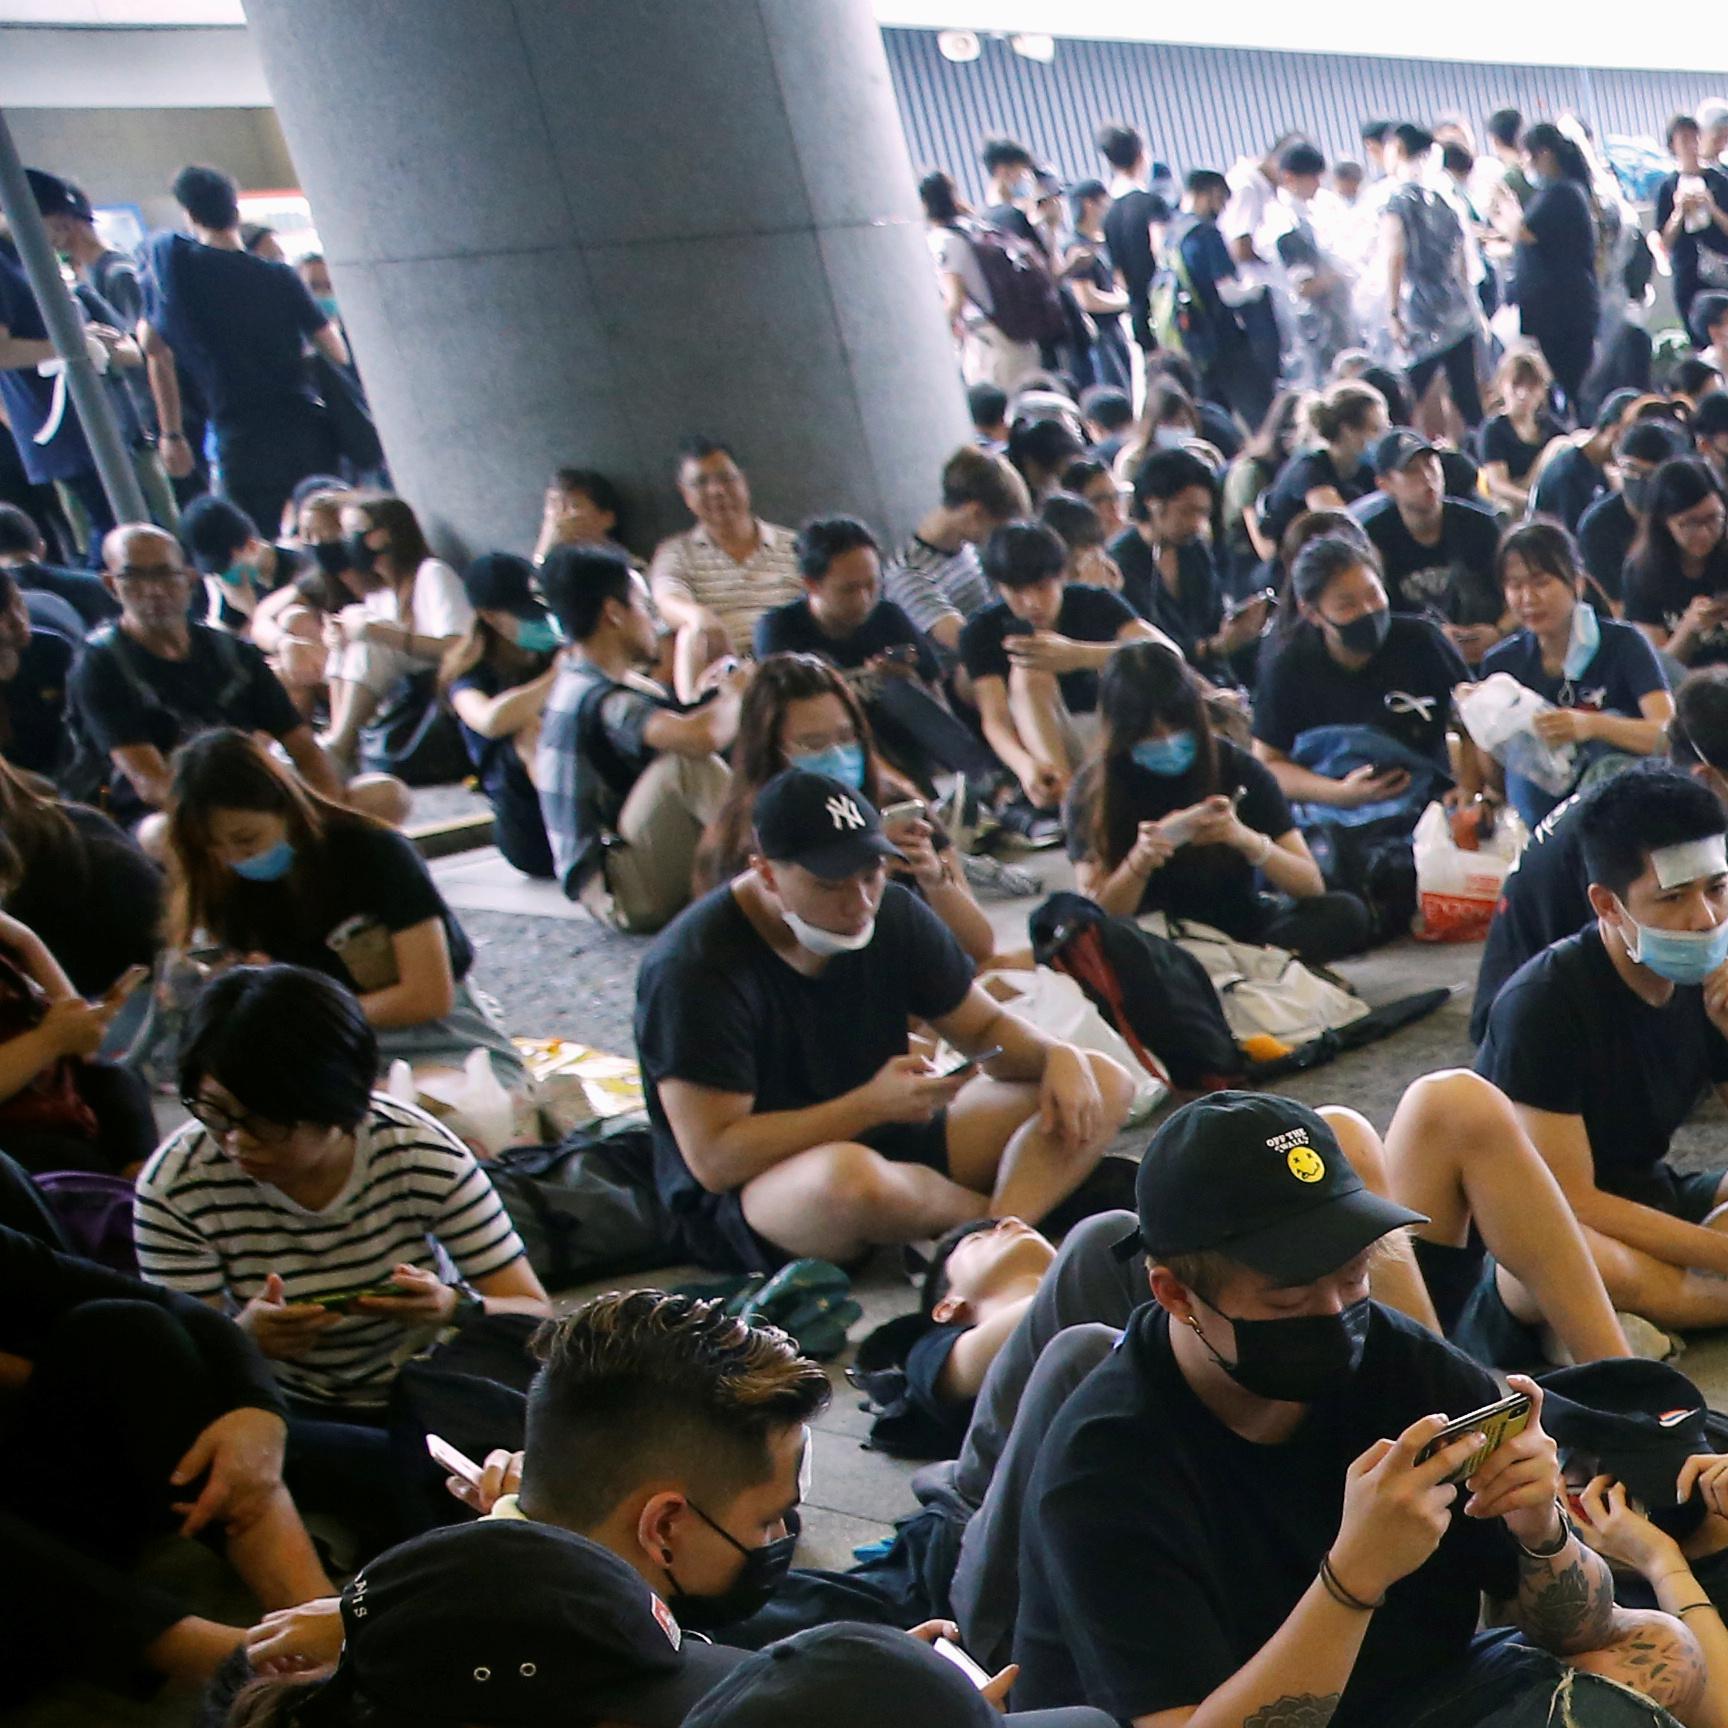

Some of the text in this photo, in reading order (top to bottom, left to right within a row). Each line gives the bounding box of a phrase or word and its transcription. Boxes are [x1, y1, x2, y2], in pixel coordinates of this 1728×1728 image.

[825, 791, 866, 831] NY
[1265, 1127, 1307, 1148] OFF THE
